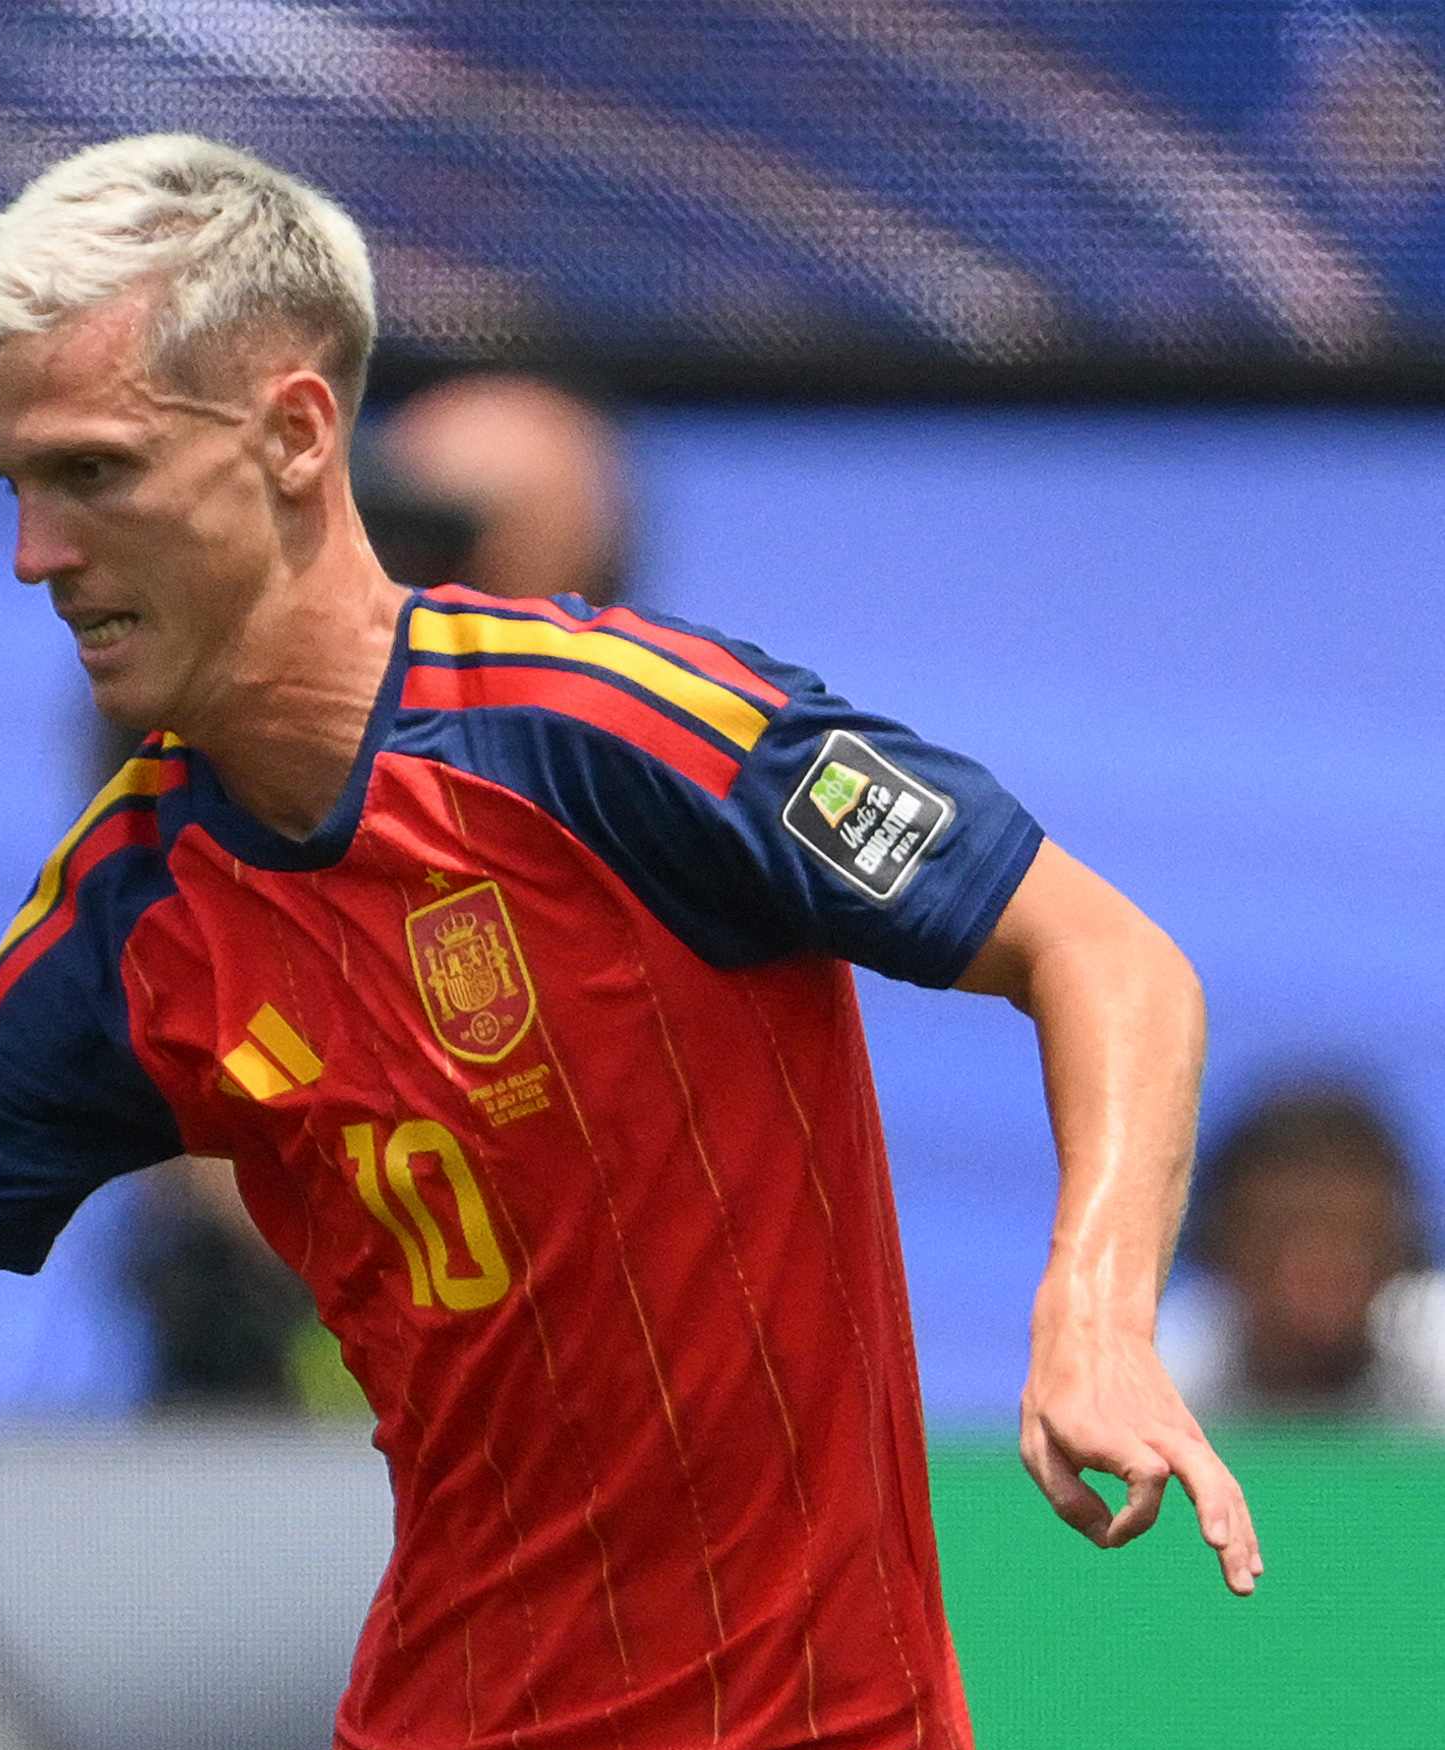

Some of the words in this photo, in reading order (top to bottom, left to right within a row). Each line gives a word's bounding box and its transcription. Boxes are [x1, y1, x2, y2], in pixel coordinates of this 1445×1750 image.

[854, 791, 922, 874] EDUCATION
[890, 831, 920, 863] FIFA
[342, 1120, 510, 1311] 10
